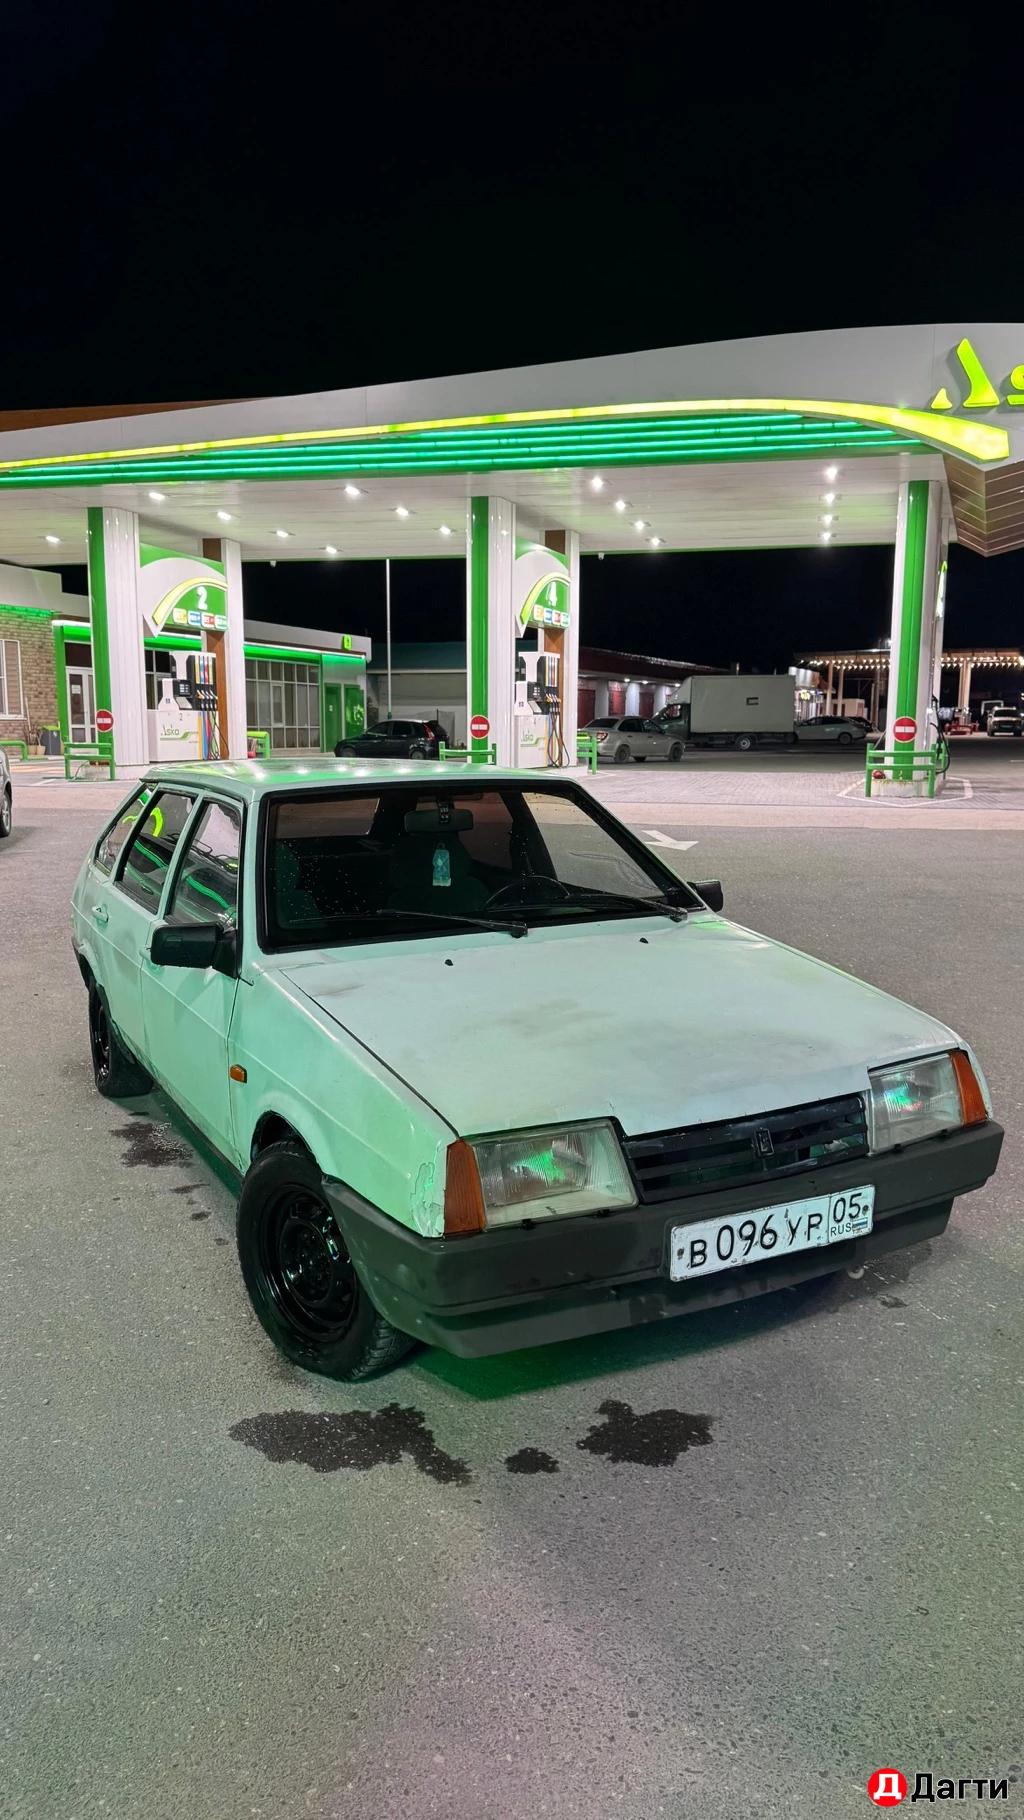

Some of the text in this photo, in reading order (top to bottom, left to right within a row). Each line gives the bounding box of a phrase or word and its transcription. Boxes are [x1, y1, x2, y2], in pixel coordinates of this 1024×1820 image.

[197, 586, 208, 610] 2
[545, 581, 557, 607] 4
[179, 713, 183, 721] 2
[833, 1192, 862, 1223] 05
[830, 1222, 851, 1237] RUS
